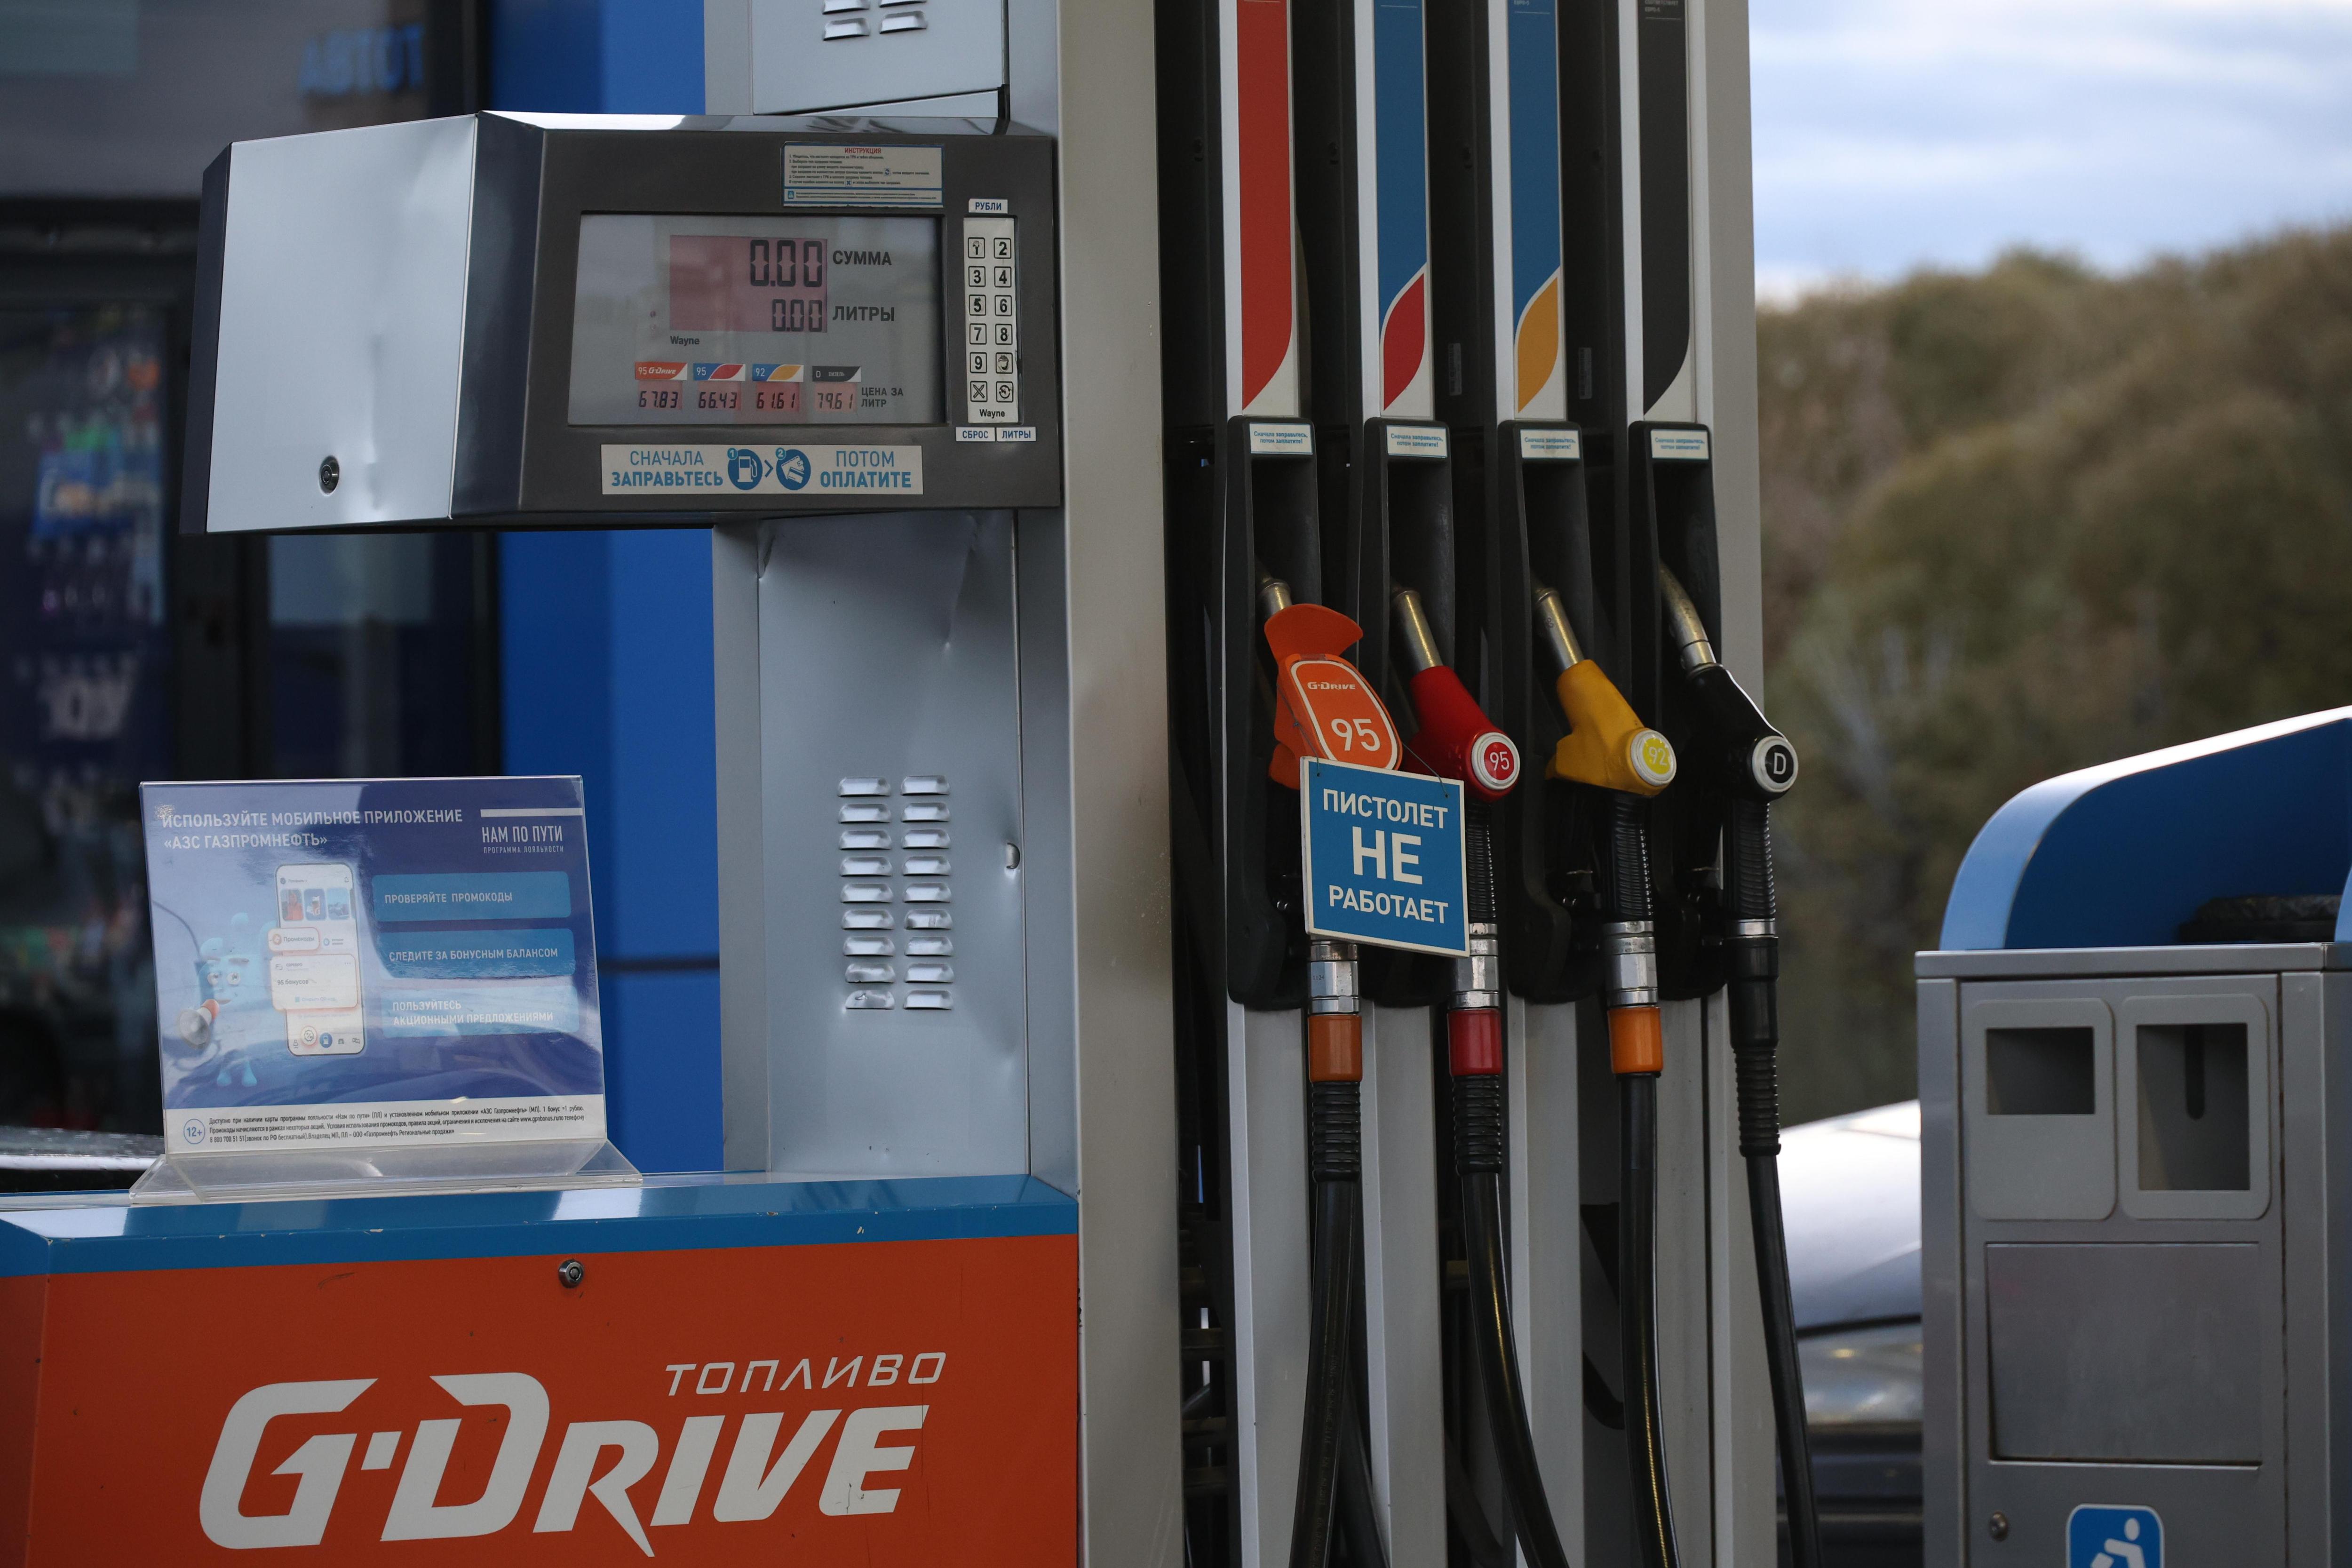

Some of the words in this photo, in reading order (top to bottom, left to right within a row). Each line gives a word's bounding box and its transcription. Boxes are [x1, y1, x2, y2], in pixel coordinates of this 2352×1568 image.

[999, 241, 1007, 255] 2
[750, 239, 822, 287] 0.00
[833, 251, 892, 265] СУММА
[973, 270, 981, 284] 3
[999, 270, 1007, 284] 4
[974, 298, 981, 312] 5
[1000, 299, 1008, 312] 6
[772, 299, 822, 332] 0.00
[833, 306, 894, 321] ЛИТРЫ
[670, 336, 700, 346] Wayne
[974, 327, 982, 341] 7
[1001, 327, 1008, 342] 8
[975, 356, 982, 370] 9
[755, 368, 765, 376] 92
[638, 391, 678, 408] 67.83
[861, 387, 887, 397] ЦЕНА
[891, 388, 904, 396] ЗА
[699, 392, 737, 408] 66.43
[756, 392, 795, 409] 61.61
[818, 393, 853, 410] 79.61
[861, 399, 887, 407] ЛИТР
[979, 409, 1005, 418] Wayne
[630, 451, 704, 466] СНАЧАЛА
[836, 451, 894, 467] ПОТОМ
[612, 471, 723, 486] ЗАПРАВЬТЕСЬ
[820, 471, 911, 488] ОПЛАТИТЕ
[1331, 718, 1380, 751] 95
[1490, 751, 1510, 771] 95
[1650, 747, 1667, 766] 92
[1773, 752, 1787, 775] D
[1323, 788, 1448, 829] ПИСТОЛЕТ
[162, 810, 268, 828] ИСПОЛЬЗУЙТЕ
[272, 811, 360, 825] МОБИЛЬНОЕ
[364, 809, 462, 823] ПРИЛОЖЕНИЕ
[164, 836, 200, 849] «АЗС
[205, 833, 327, 848] ГАЗПРОМНЕФТЬ»
[482, 826, 508, 843] НАМ
[512, 826, 528, 842] ПО
[532, 826, 563, 842] ПУТИ
[1352, 826, 1422, 884] НЕ
[384, 892, 446, 904] ПРОВЕРЯЙТЕ
[452, 892, 512, 902] ПРОМОКОДЫ
[1329, 885, 1448, 924] РАБОТАЕТ
[389, 951, 433, 963] СЛЕДИТЕ
[436, 951, 447, 960] ЗА
[450, 949, 504, 960] БОНУСНЫМ
[507, 948, 558, 958] БАЛАНСОМ
[393, 999, 461, 1011] ПОЛЬЗУЙТЕСЬ
[394, 1014, 464, 1026] АКЦИОННЫМИ
[467, 1012, 553, 1024] ПРЕДЛОЖЕНИЯМИ
[187, 1127, 202, 1137] 12+
[666, 1352, 946, 1396] ТОПЛИВО
